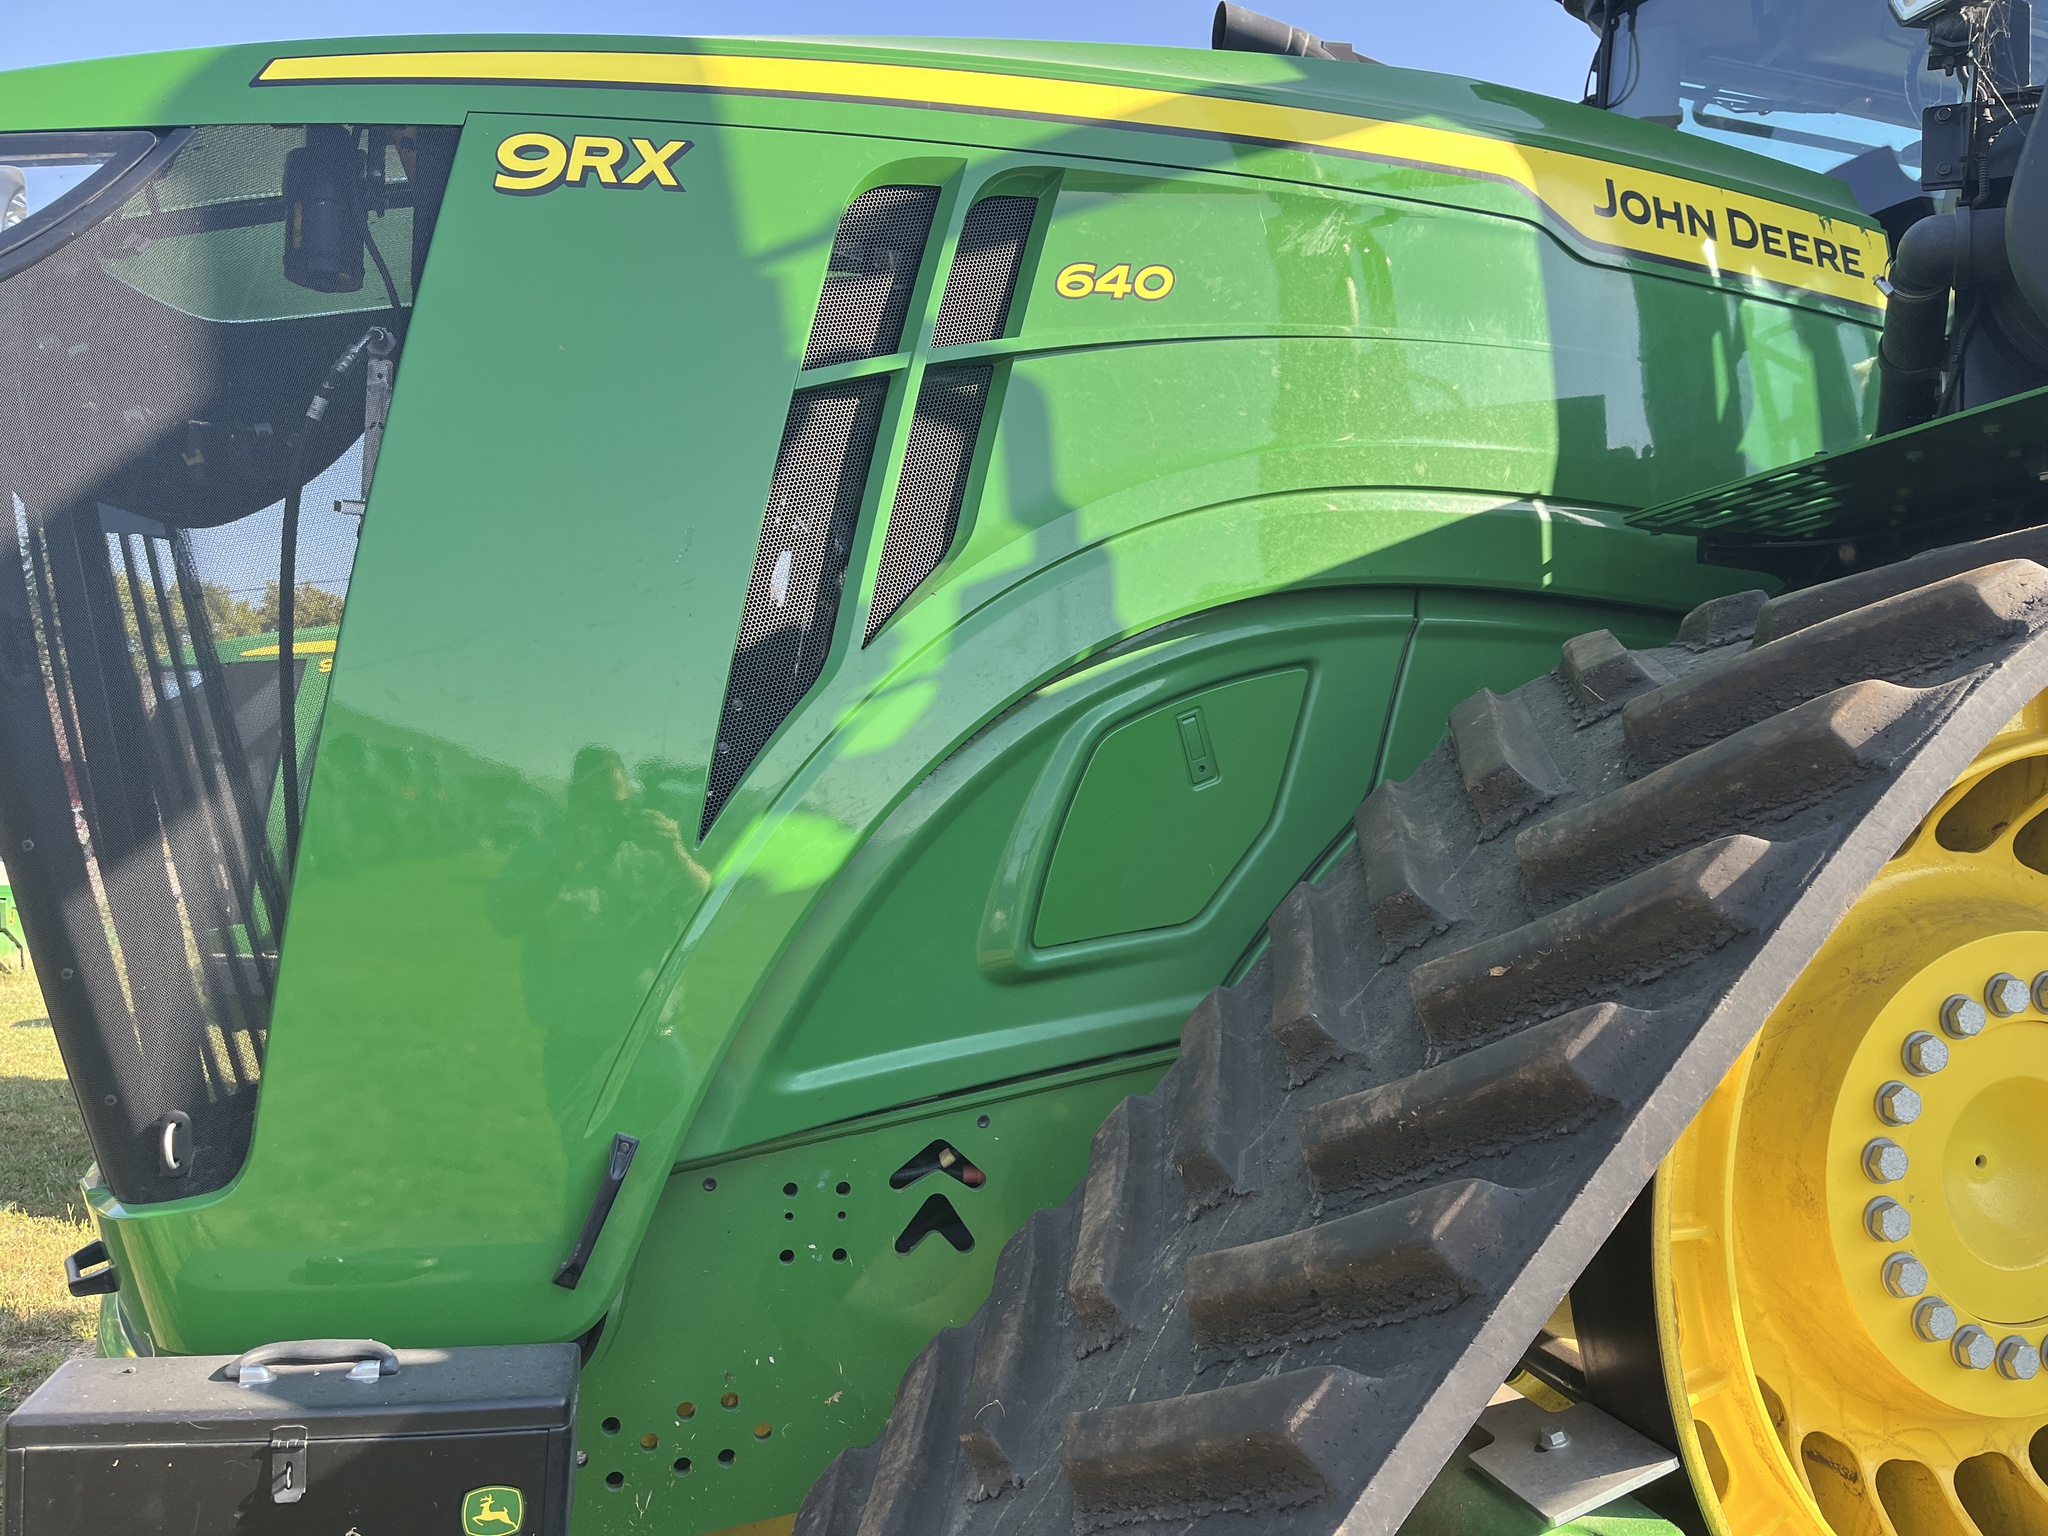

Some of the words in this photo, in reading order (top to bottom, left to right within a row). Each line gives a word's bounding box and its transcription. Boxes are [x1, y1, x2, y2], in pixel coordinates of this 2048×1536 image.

[493, 132, 695, 197] 9RX
[1593, 178, 1717, 241] JOHN
[1726, 208, 1865, 279] DEERE
[1055, 262, 1175, 302] 640
